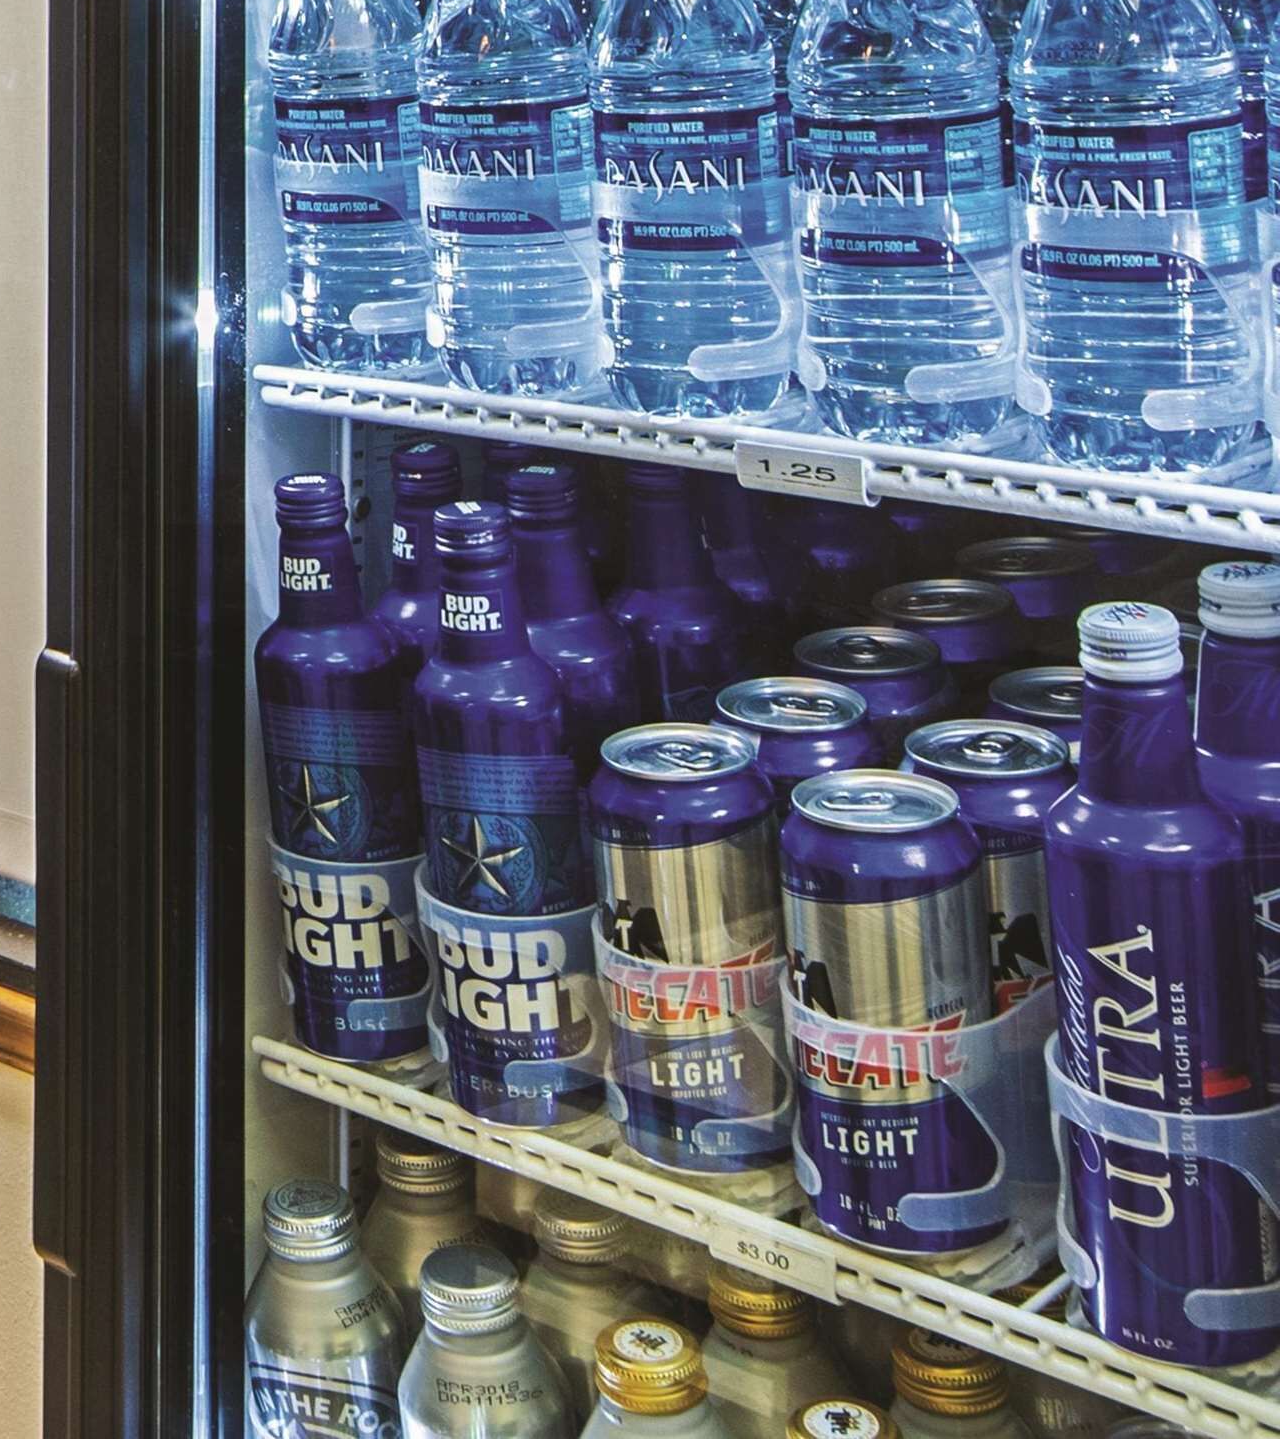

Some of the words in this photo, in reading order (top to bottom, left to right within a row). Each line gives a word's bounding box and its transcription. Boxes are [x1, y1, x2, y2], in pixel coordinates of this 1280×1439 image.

[628, 121, 669, 133] PURIFIED
[672, 121, 704, 133] WATER
[844, 130, 877, 142] WATER
[1078, 135, 1115, 150] WATER
[277, 134, 384, 182] DASANI
[423, 140, 535, 190] DASANI
[605, 150, 745, 204] DASANI
[796, 160, 925, 213] DASANI
[1018, 167, 1167, 225] DASANI
[659, 226, 671, 238] OZ
[694, 225, 708, 238] PT)
[868, 240, 882, 253] PT)
[884, 240, 903, 253] 500
[1067, 252, 1078, 264] OZ
[1079, 253, 1102, 267] (1.06
[1103, 254, 1121, 267] PT)
[1122, 254, 1143, 268] 500
[1145, 254, 1162, 267] mL
[756, 458, 837, 486] 1.25
[281, 571, 332, 591] LIGHT
[284, 556, 322, 576] BUD
[441, 609, 502, 632] LIGHT
[446, 593, 491, 614] BUD
[273, 863, 390, 920] BUD
[282, 910, 413, 969] IGHT
[431, 921, 567, 980] BUD
[441, 971, 590, 1033] IGHT
[1169, 981, 1189, 1029] BEER
[797, 1009, 967, 1088] ECATE
[1174, 1030, 1193, 1091] LIGHT
[651, 1054, 744, 1087] LIGHT
[1087, 924, 1175, 1230] ULTRA
[821, 1122, 919, 1157] LIGHT
[1176, 1094, 1199, 1187] SUPERIOR
[736, 1238, 791, 1272] $3.00
[254, 1385, 274, 1413] IN
[275, 1389, 330, 1421] THE
